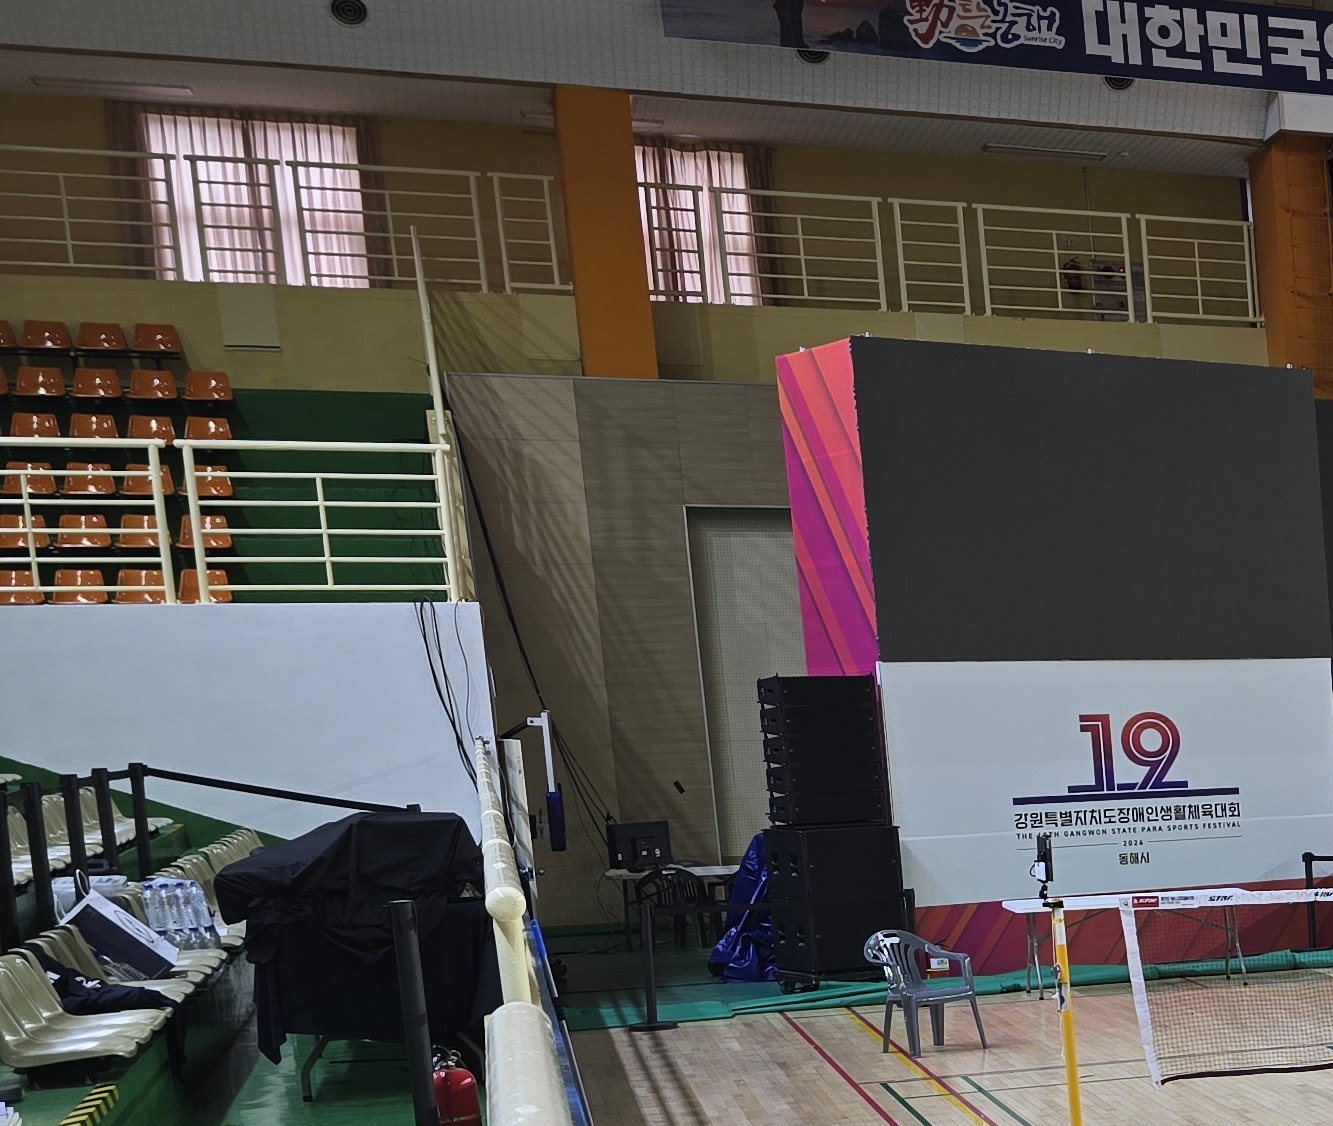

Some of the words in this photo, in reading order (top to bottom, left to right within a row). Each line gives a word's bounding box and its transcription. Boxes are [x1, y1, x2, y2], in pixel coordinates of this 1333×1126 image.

[1023, 34, 1048, 44] Sunrise
[1048, 37, 1062, 46] City
[1067, 711, 1189, 794] 19
[1016, 832, 1033, 840] THE
[1063, 828, 1107, 838] GANGWON
[1111, 826, 1138, 835] STATE
[1141, 825, 1164, 833] PARA
[1166, 823, 1199, 832] SPORTS
[1202, 820, 1242, 830] FESTIVAL
[1118, 851, 1151, 866] 동해시
